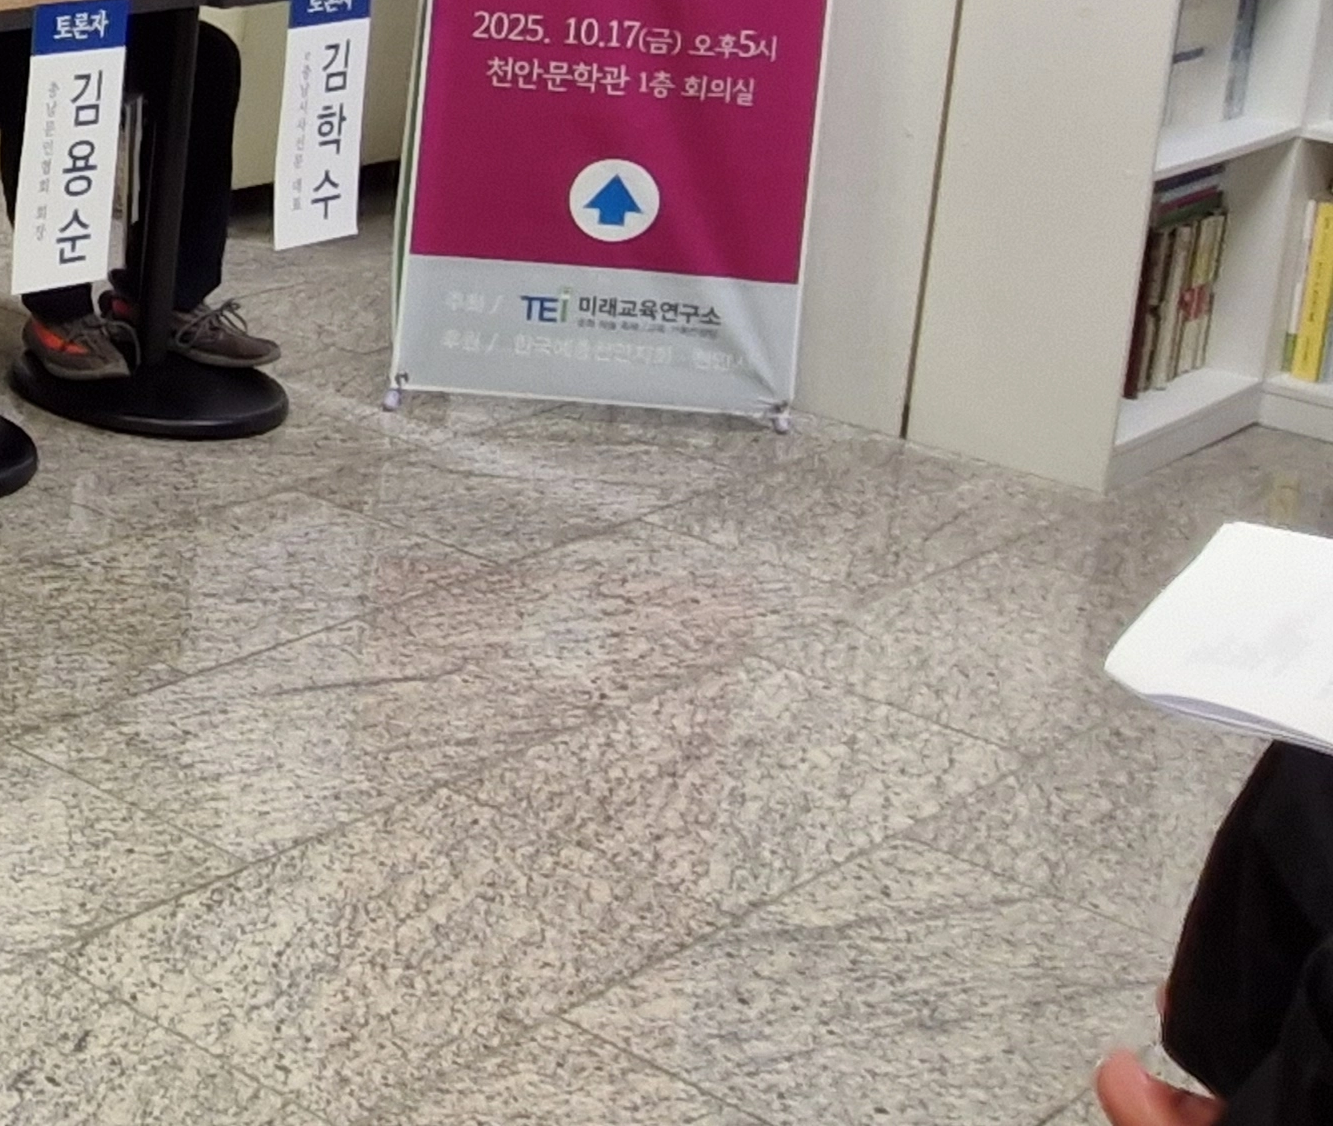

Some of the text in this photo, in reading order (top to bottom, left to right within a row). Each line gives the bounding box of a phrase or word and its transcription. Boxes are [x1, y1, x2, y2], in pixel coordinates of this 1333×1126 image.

[53, 9, 109, 40] 토론자
[472, 10, 779, 61] 2025. 10.17(금) 오후5시
[486, 57, 756, 105] 천안문학관 1층 회의실
[310, 39, 351, 220] 김학수
[56, 69, 103, 265] 김용순
[578, 296, 722, 326] 미래교육연구소
